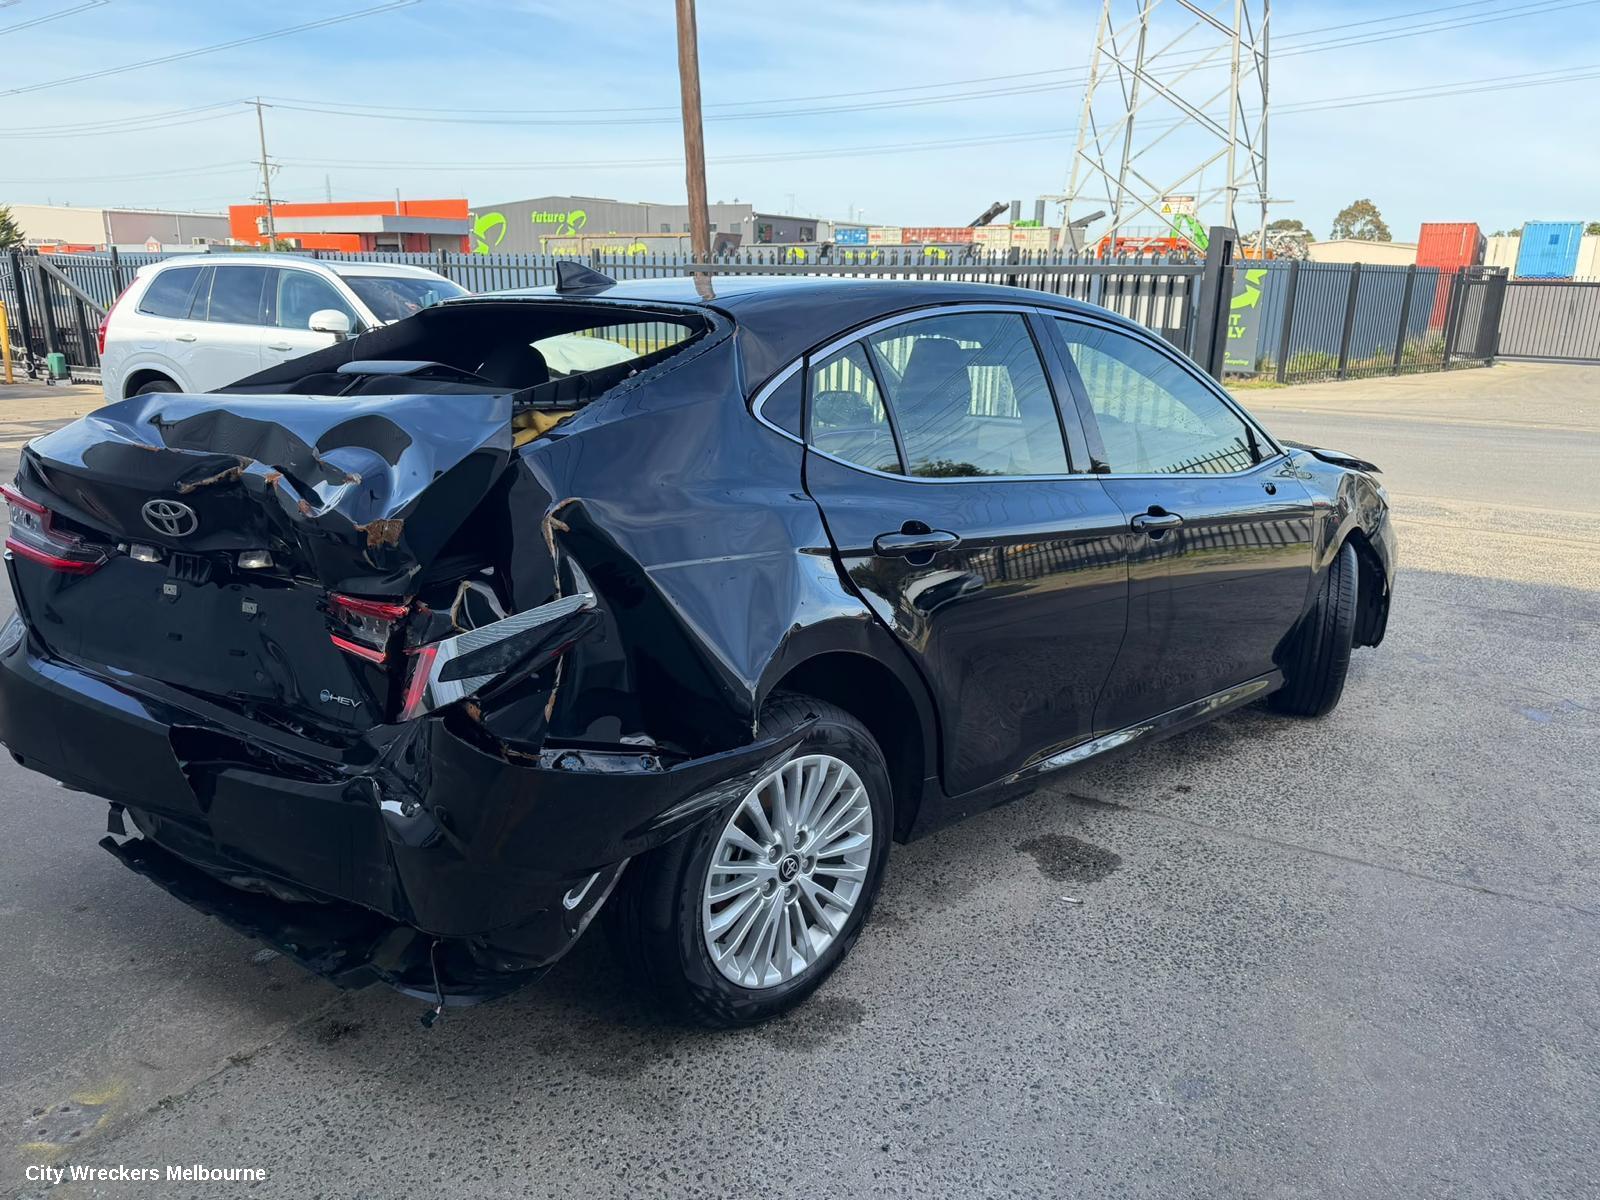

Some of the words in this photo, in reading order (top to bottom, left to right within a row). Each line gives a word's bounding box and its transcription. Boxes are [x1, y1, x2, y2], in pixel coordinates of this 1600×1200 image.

[531, 211, 566, 223] future
[1227, 326, 1247, 338] LY
[329, 694, 362, 708] HEV
